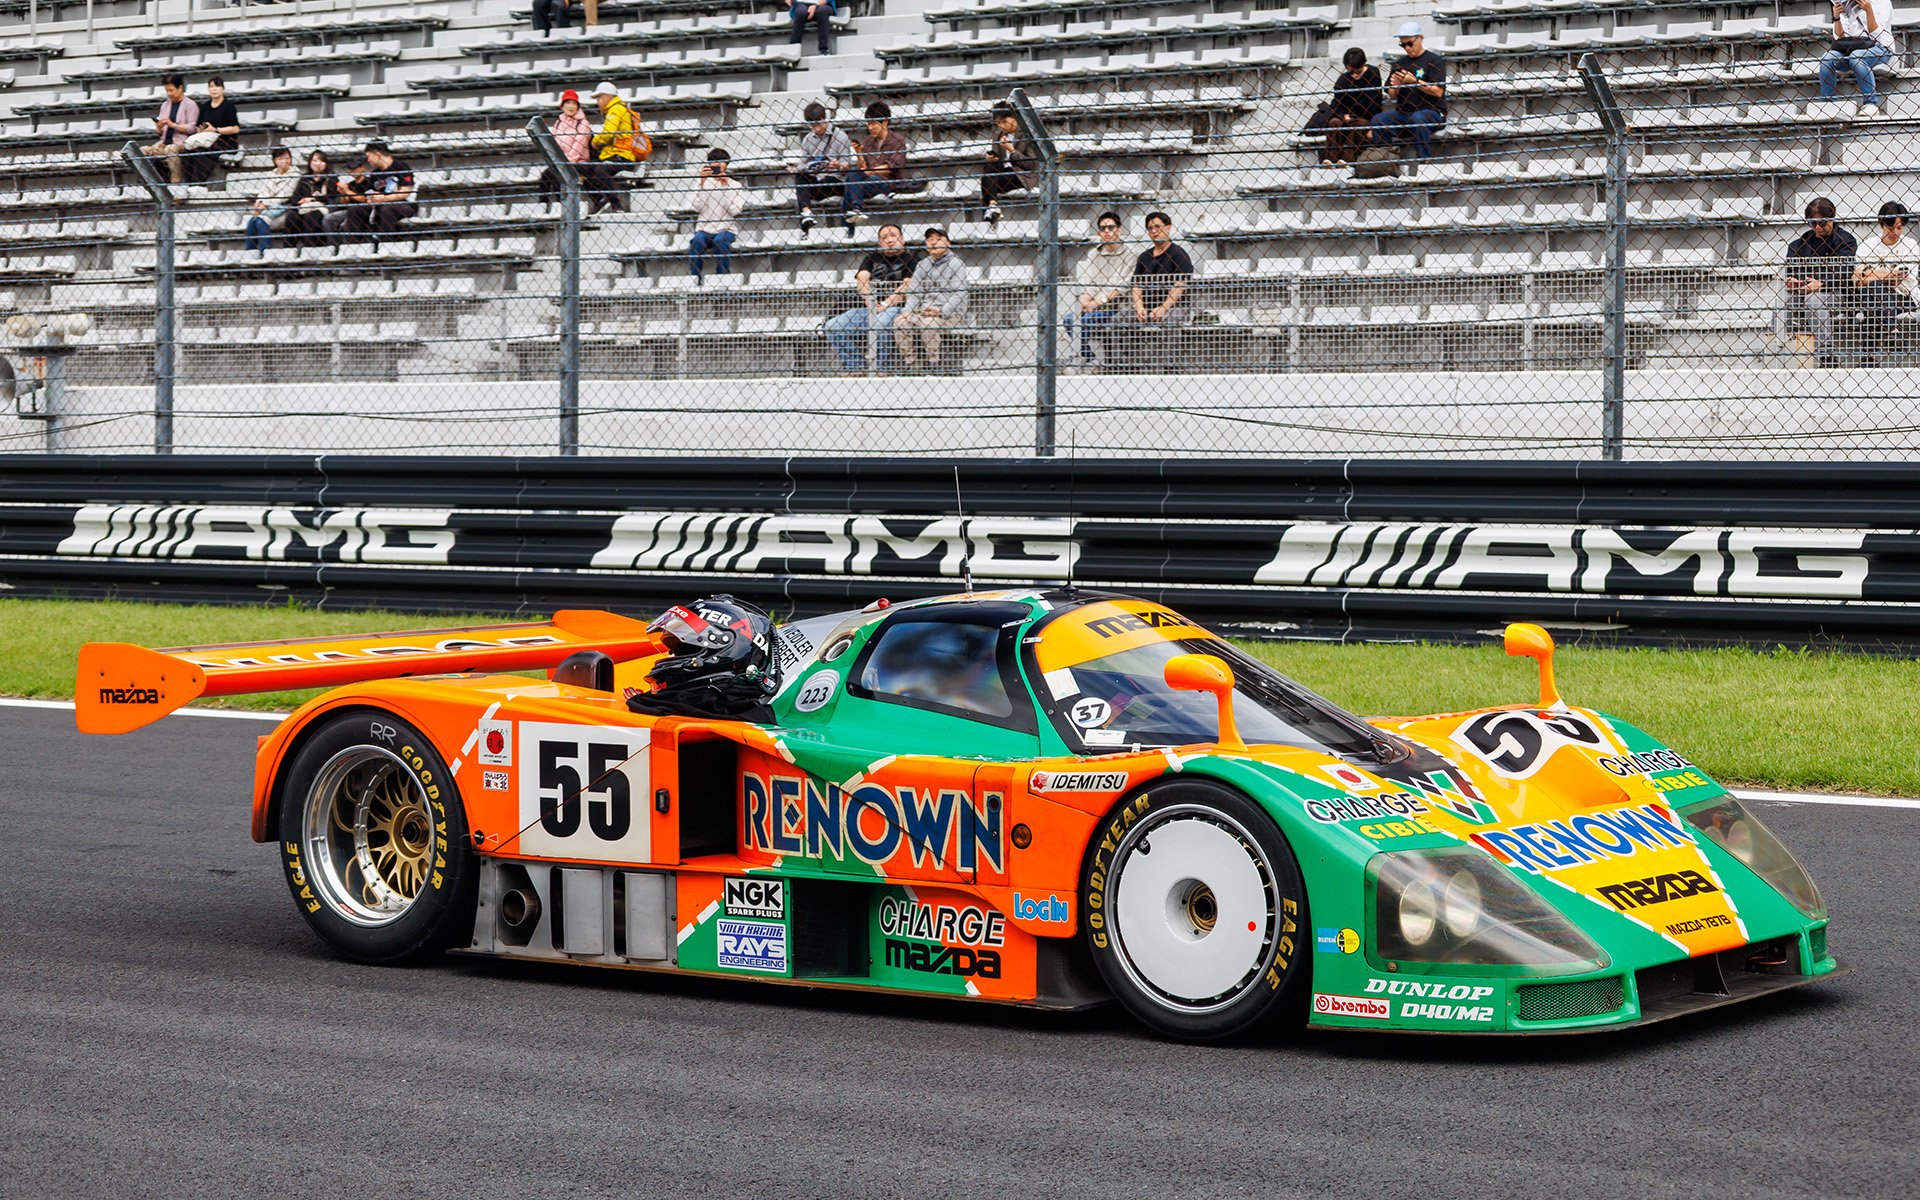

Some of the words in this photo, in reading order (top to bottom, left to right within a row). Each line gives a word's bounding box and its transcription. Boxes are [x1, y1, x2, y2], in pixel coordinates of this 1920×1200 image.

[100, 683, 159, 704] mazda
[800, 685, 828, 706] 223
[1076, 703, 1105, 723] 37
[370, 722, 397, 746] RR
[539, 740, 631, 842] 55
[1051, 774, 1147, 790] IDEMITSU
[1304, 793, 1429, 823] CHARGE
[743, 771, 1004, 874] RENOWN
[1481, 806, 1698, 873] RENOWN
[286, 841, 322, 913] EAGLE
[1089, 793, 1150, 948] GOODYEAR
[728, 880, 782, 909] NGK
[1595, 870, 1720, 911] mazda
[727, 908, 755, 916] SPARK
[756, 910, 783, 918] PLUGS
[880, 897, 1006, 947] CHARGE
[1665, 920, 1706, 936] MAZDA
[719, 935, 785, 957] RAYS
[1266, 898, 1298, 990] EAGLE
[719, 955, 785, 968] ENGINEERING
[885, 938, 1001, 979] mazda
[1364, 978, 1494, 1000] DUNLOP
[1331, 997, 1387, 1014] brembo
[1400, 1002, 1494, 1021] D40/M2
